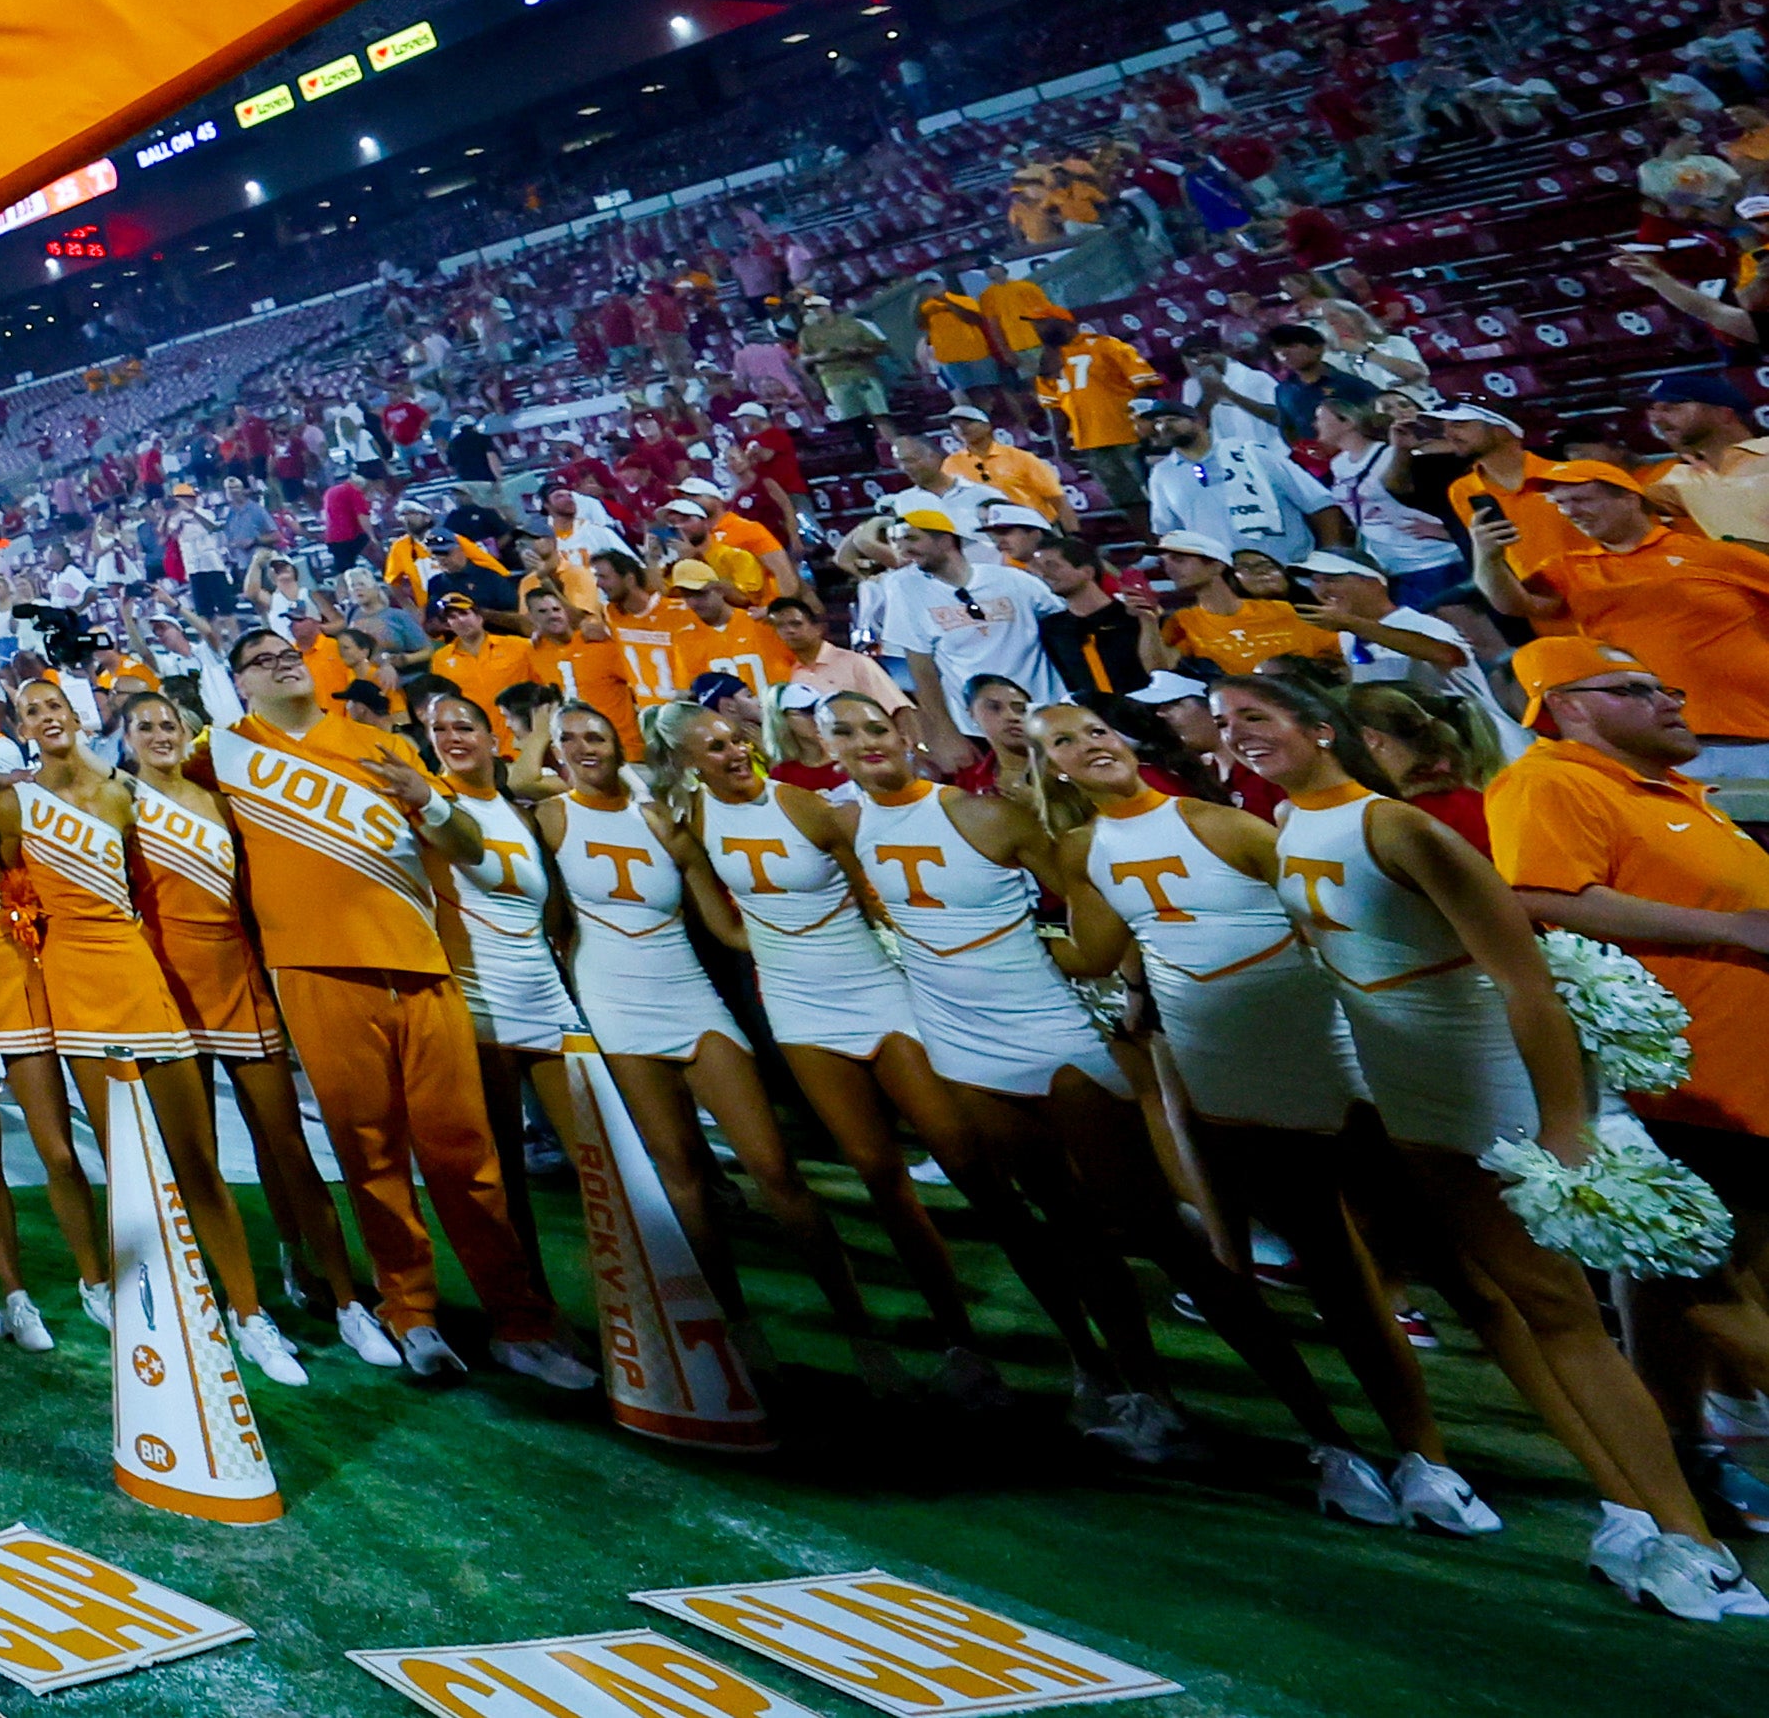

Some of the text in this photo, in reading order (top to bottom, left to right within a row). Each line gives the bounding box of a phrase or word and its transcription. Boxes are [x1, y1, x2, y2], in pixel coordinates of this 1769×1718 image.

[136, 141, 171, 168] BALL
[170, 127, 195, 153] ON
[624, 645, 678, 700] 11
[29, 796, 123, 869] VOLS
[138, 793, 235, 868] VOLS
[247, 749, 402, 851] VOLS
[585, 841, 653, 902] T
[722, 837, 788, 894] T
[876, 845, 945, 908] T
[1112, 855, 1196, 922] T
[1284, 856, 1352, 931] T
[578, 1140, 646, 1390] ROCKY TOP
[166, 1182, 263, 1463] ROCKY TOP
[677, 1318, 758, 1412] T
[140, 1439, 169, 1468] BR
[681, 1582, 1112, 1708] CLAP
